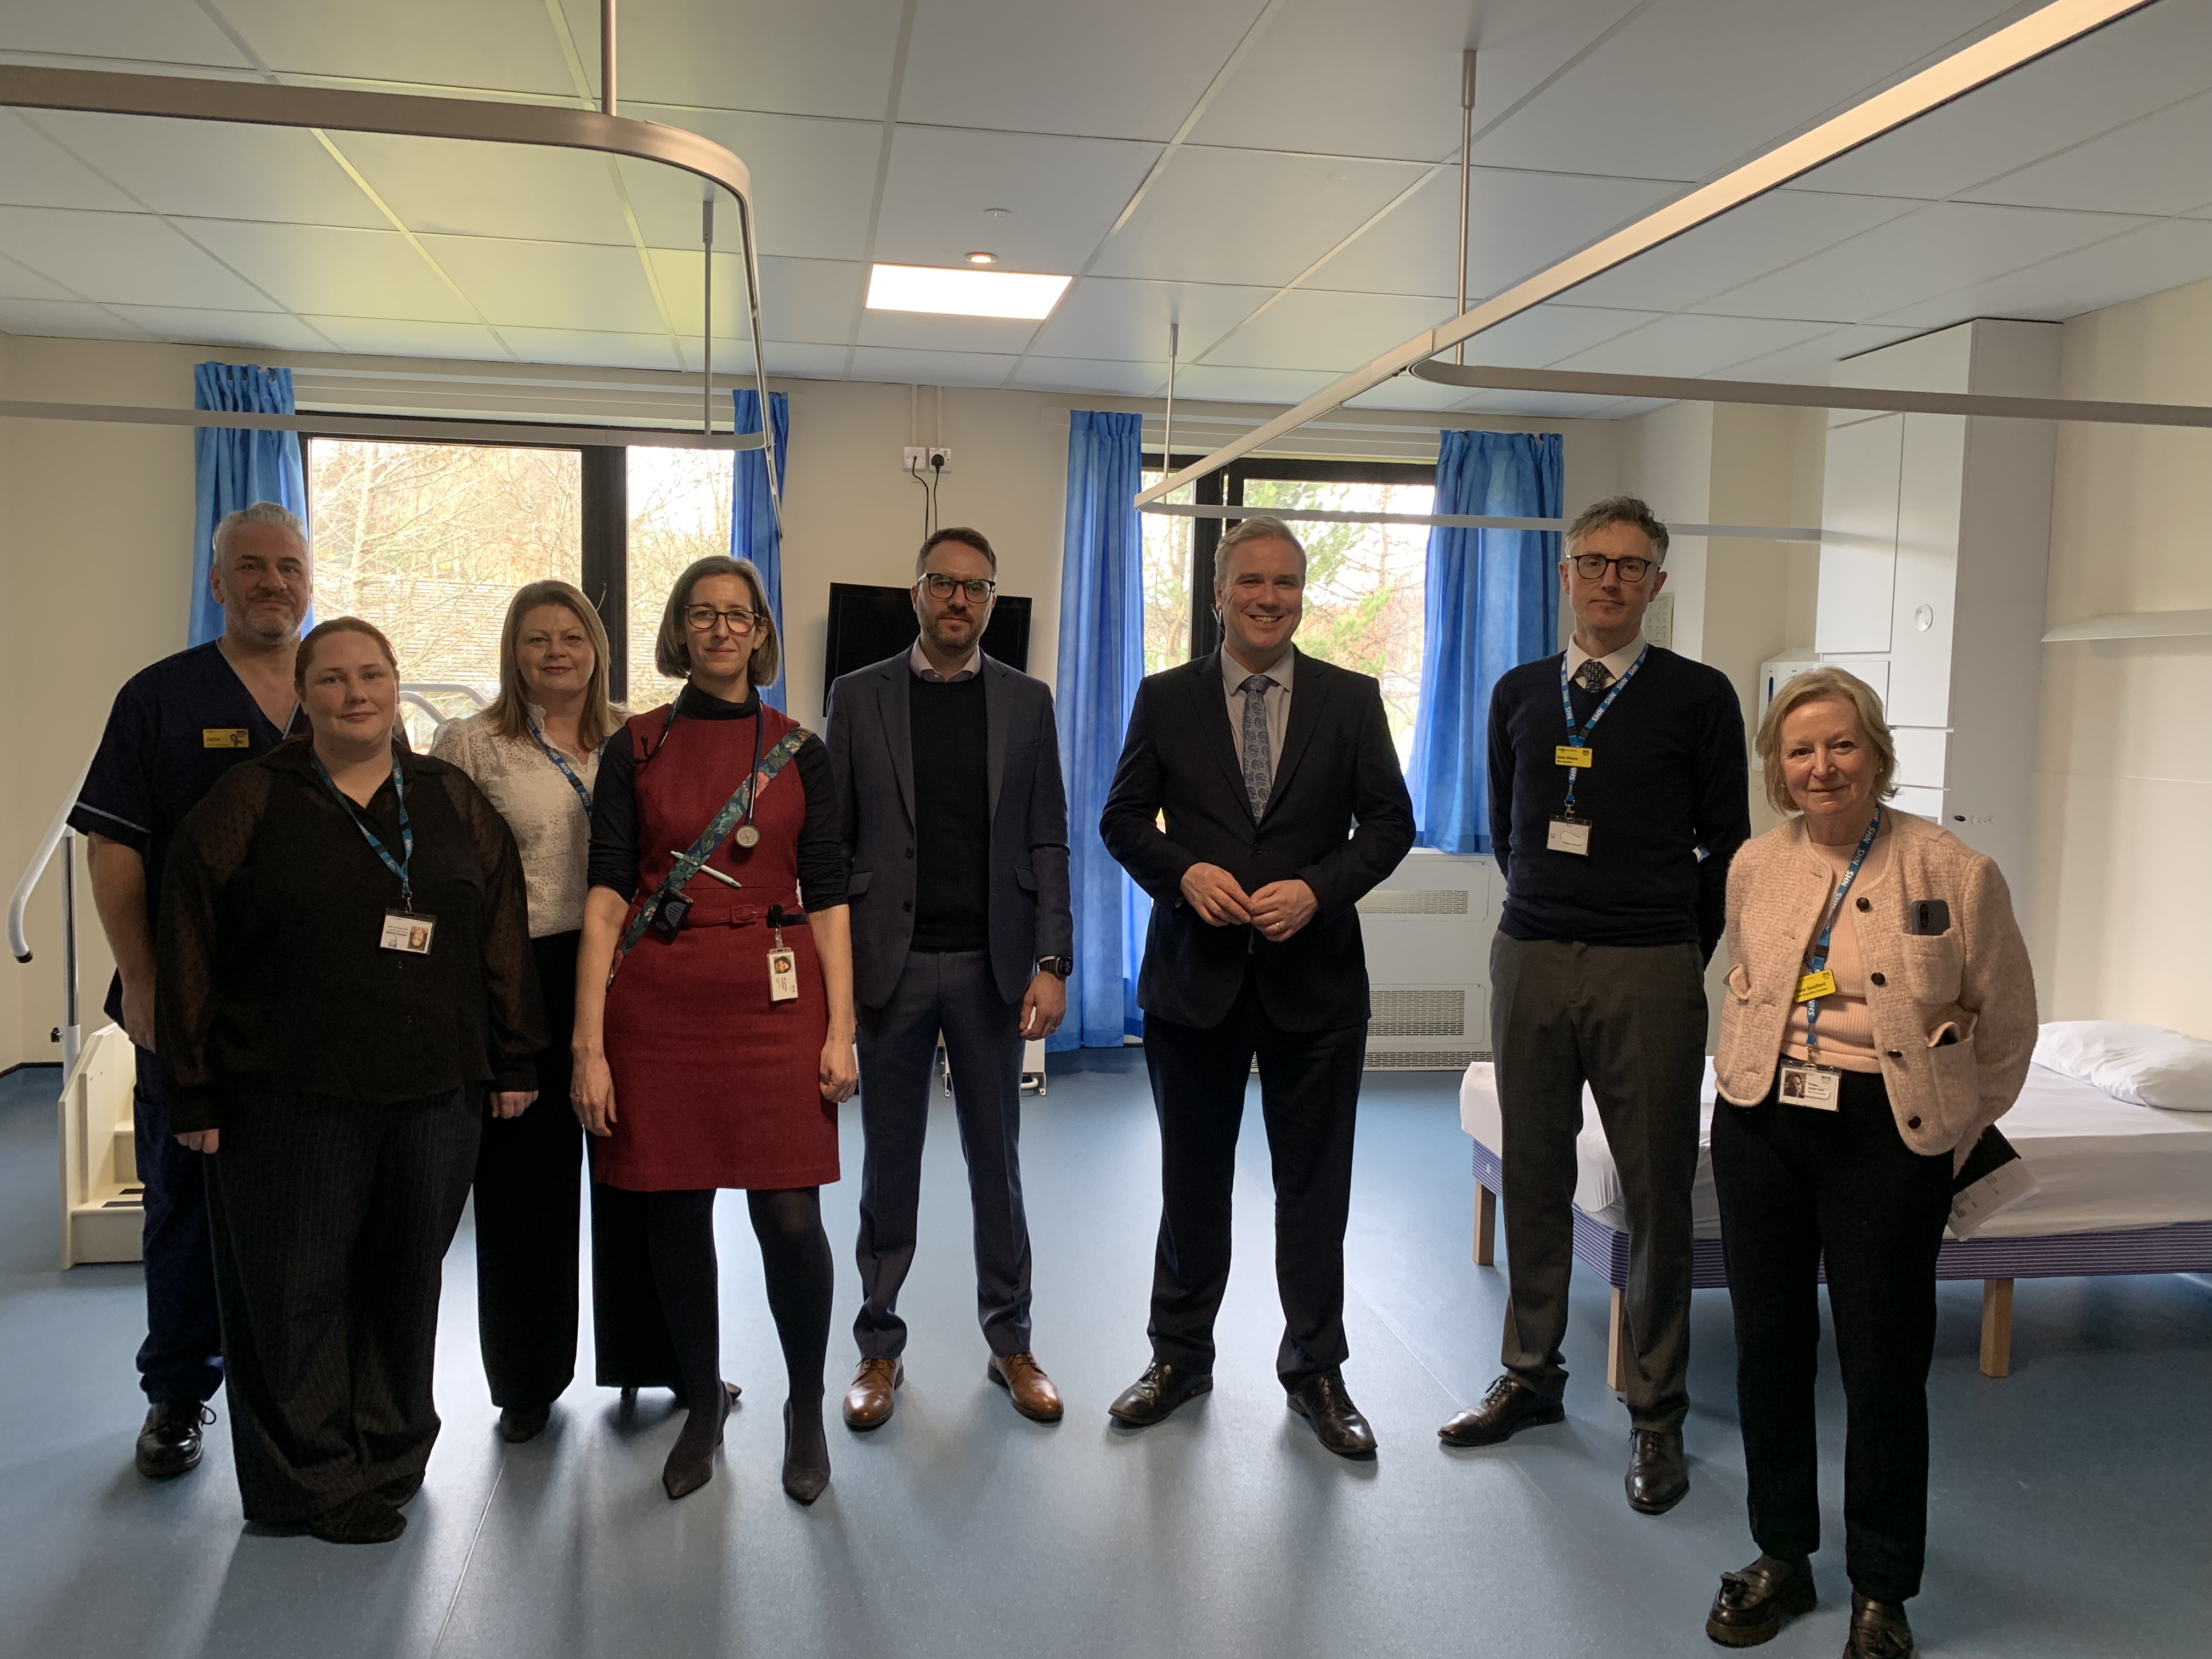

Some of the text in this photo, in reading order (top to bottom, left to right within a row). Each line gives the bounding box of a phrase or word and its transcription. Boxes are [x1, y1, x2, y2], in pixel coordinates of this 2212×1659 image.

[1628, 664, 1639, 676] NHS
[1616, 677, 1628, 690] NHS
[1604, 692, 1617, 706] NHS
[1565, 706, 1573, 719] NHS
[1592, 708, 1605, 722] NHS
[548, 748, 560, 760] NHS
[559, 763, 572, 775] NHS
[580, 792, 591, 806] NHS
[1863, 826, 1876, 844] NHS
[1852, 848, 1865, 866] NHS
[1841, 870, 1854, 887] NHS
[1807, 981, 1826, 990] Sandford
